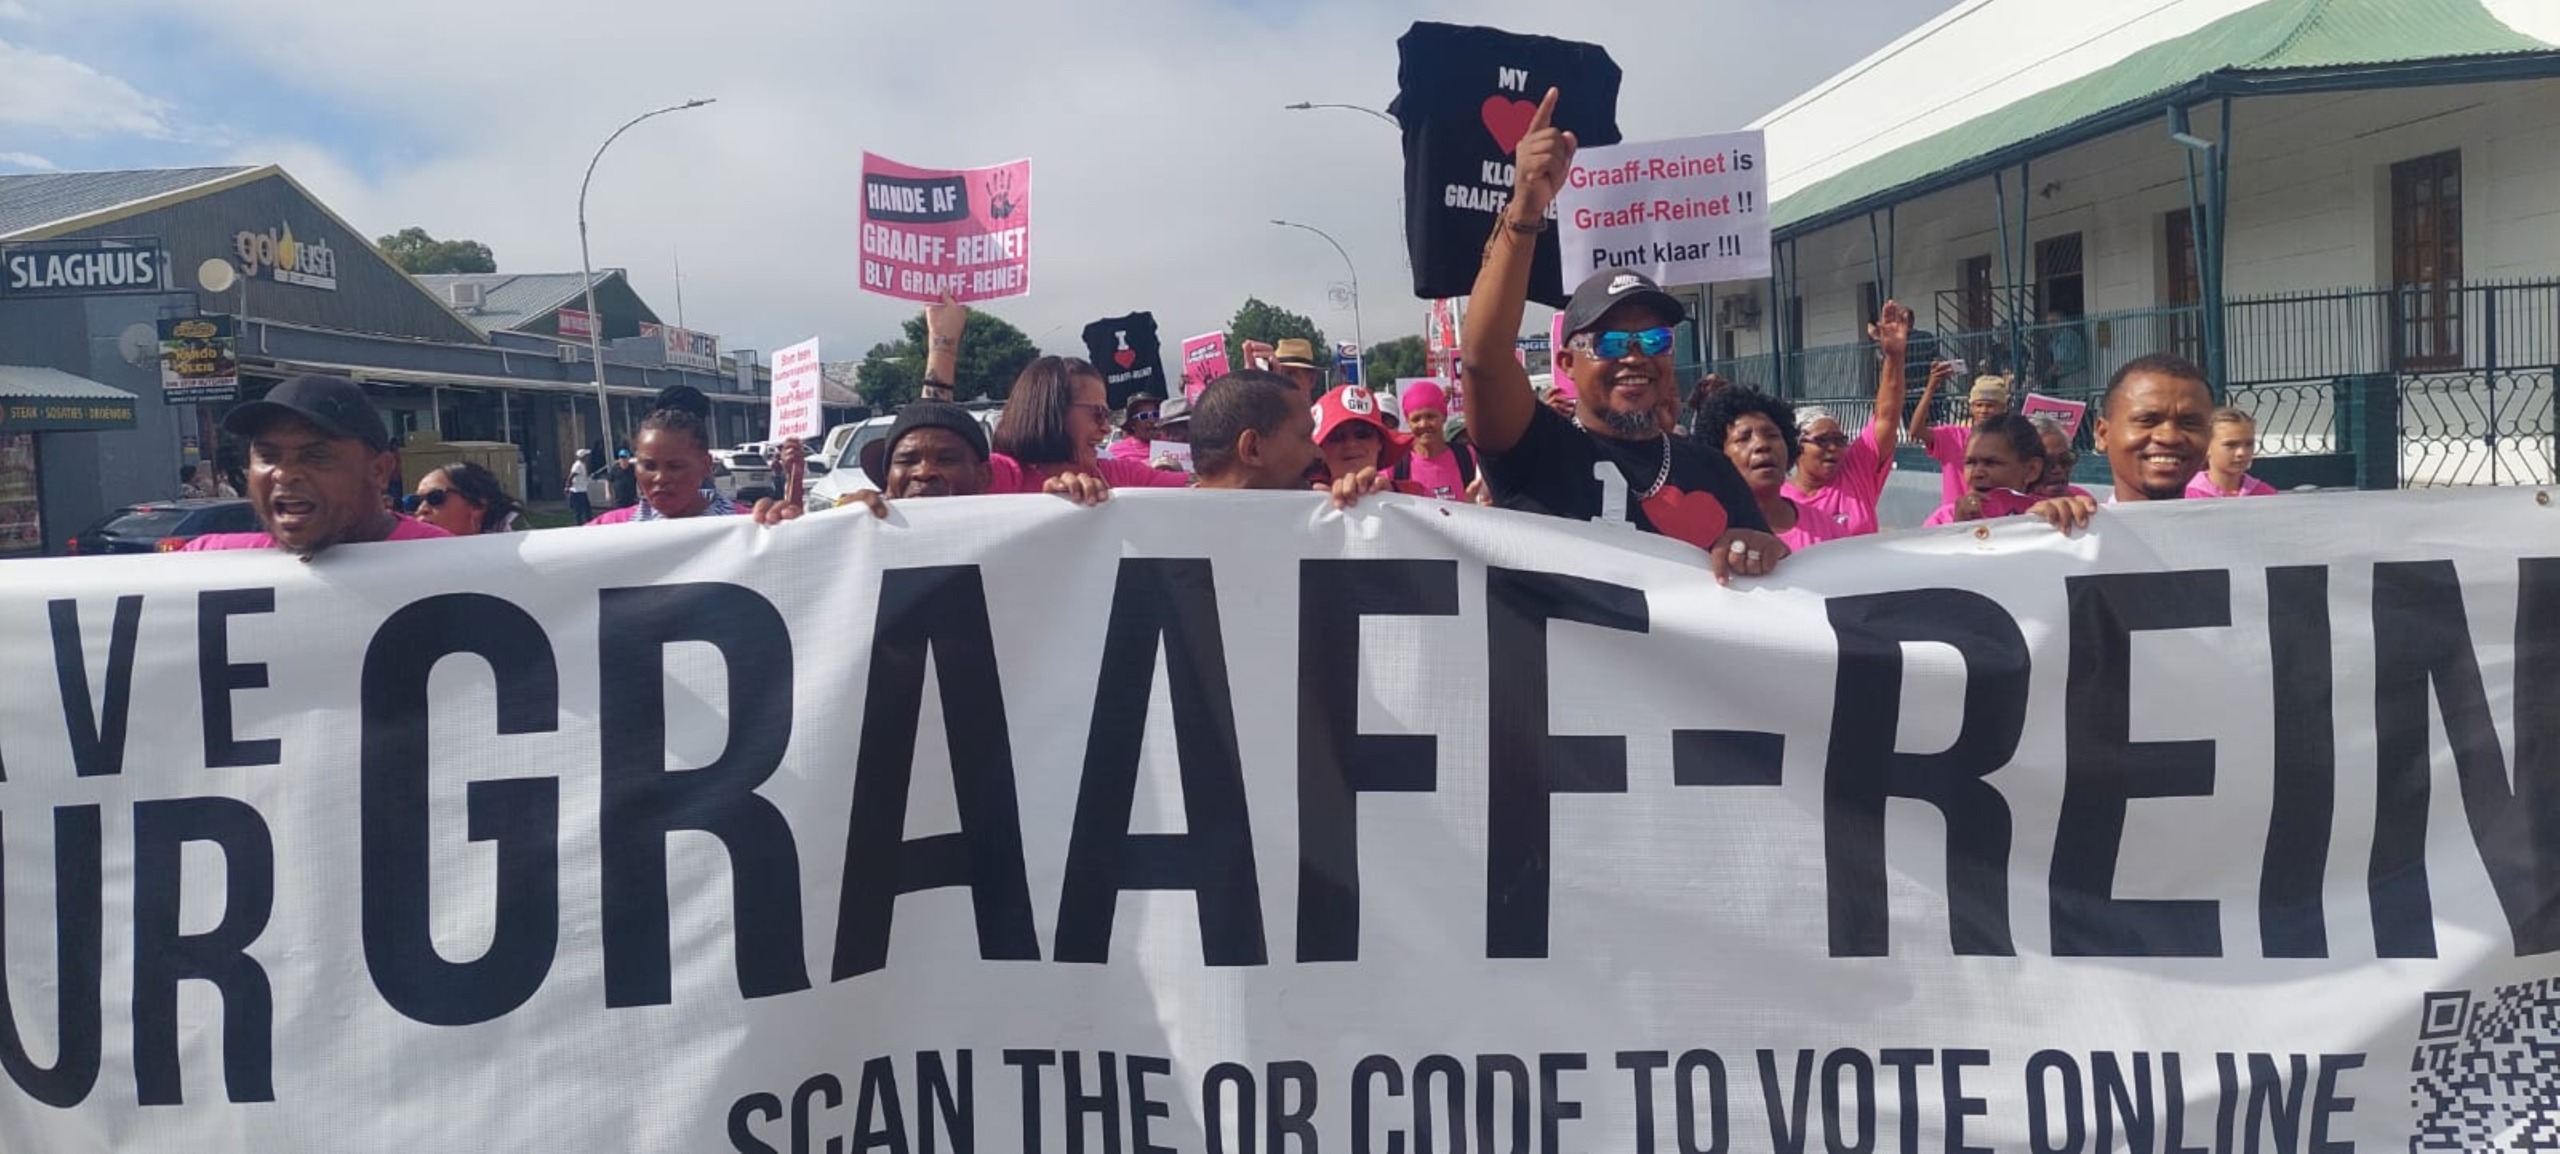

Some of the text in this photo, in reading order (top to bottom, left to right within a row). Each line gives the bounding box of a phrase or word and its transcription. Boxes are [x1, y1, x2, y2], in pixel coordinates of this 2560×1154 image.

[1498, 66, 1529, 92] MY
[1481, 160, 1515, 188] KLO
[1569, 149, 1754, 189] Graaff-Reinet is
[867, 182, 957, 213] HANDE AF
[1575, 191, 1753, 230] Graaff-Reinet !!
[862, 223, 1027, 266] GRAAFF-REINET
[1592, 244, 1647, 269] Punt
[1653, 241, 1711, 264] klaar
[10, 252, 154, 288] SLAGHUIS
[865, 260, 1024, 295] BLY GRAAFF-REINET
[727, 1048, 975, 1154] SCAN
[1003, 1048, 1178, 1154] THE
[1351, 1053, 1587, 1154] CODE
[1615, 1049, 1730, 1154] TO
[1755, 1047, 1995, 1154] VOTE
[2025, 1049, 2367, 1154] ONLINE
